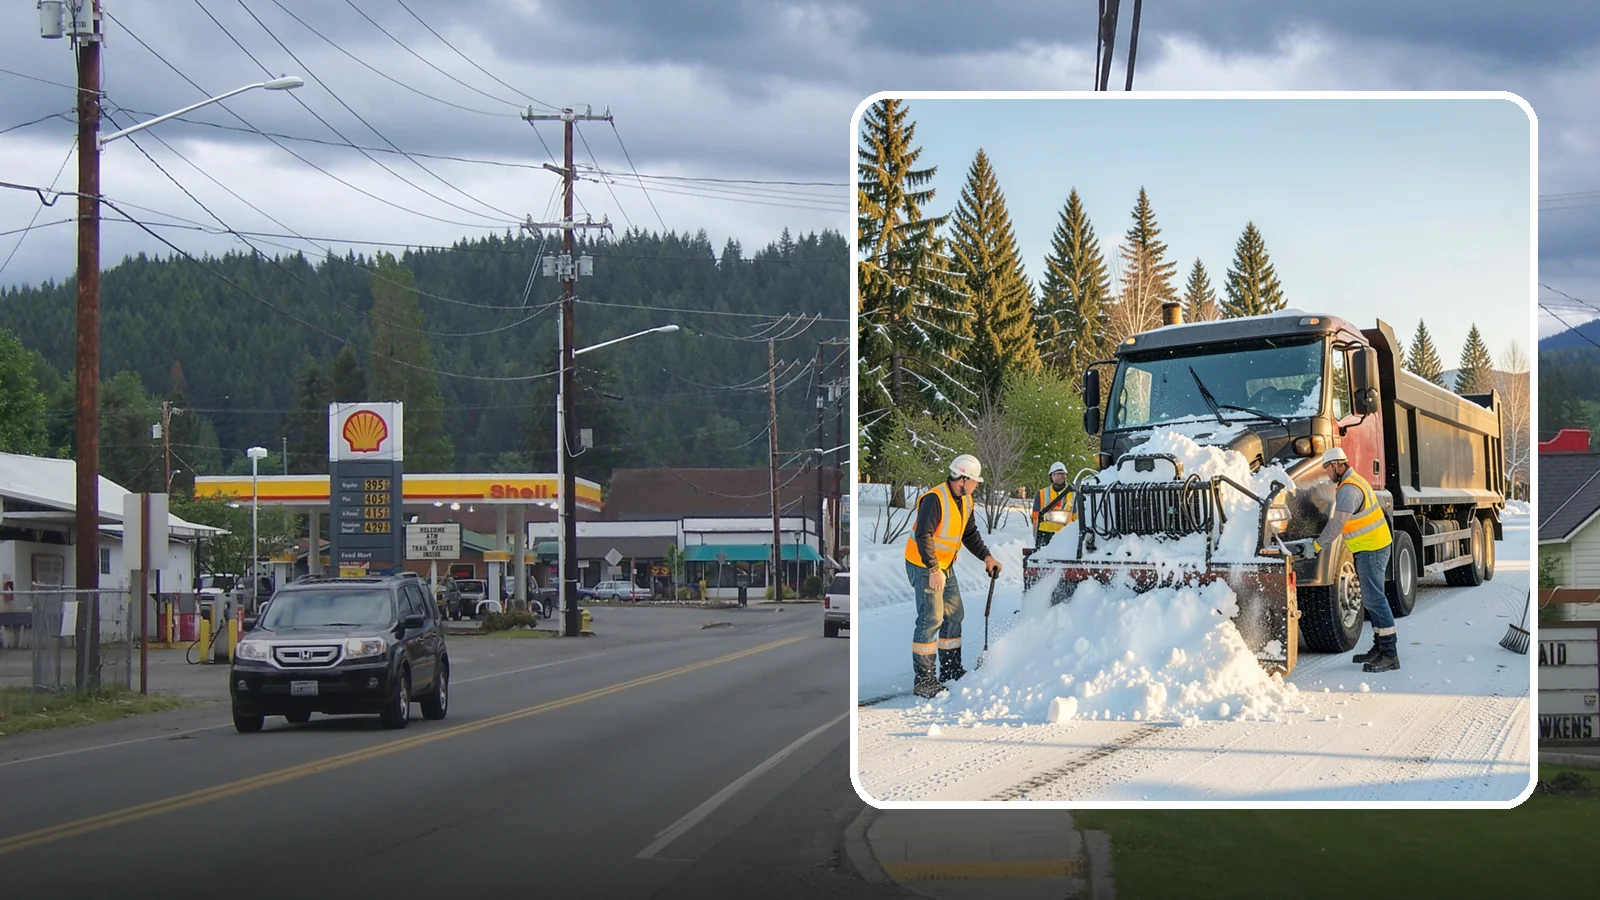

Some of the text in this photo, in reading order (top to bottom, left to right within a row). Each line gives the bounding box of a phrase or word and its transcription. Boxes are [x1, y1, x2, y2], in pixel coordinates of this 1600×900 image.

[366, 480, 383, 490] 395
[490, 484, 547, 499] Shell
[366, 494, 383, 504] 405
[366, 508, 383, 518] 415
[366, 522, 383, 532] 429
